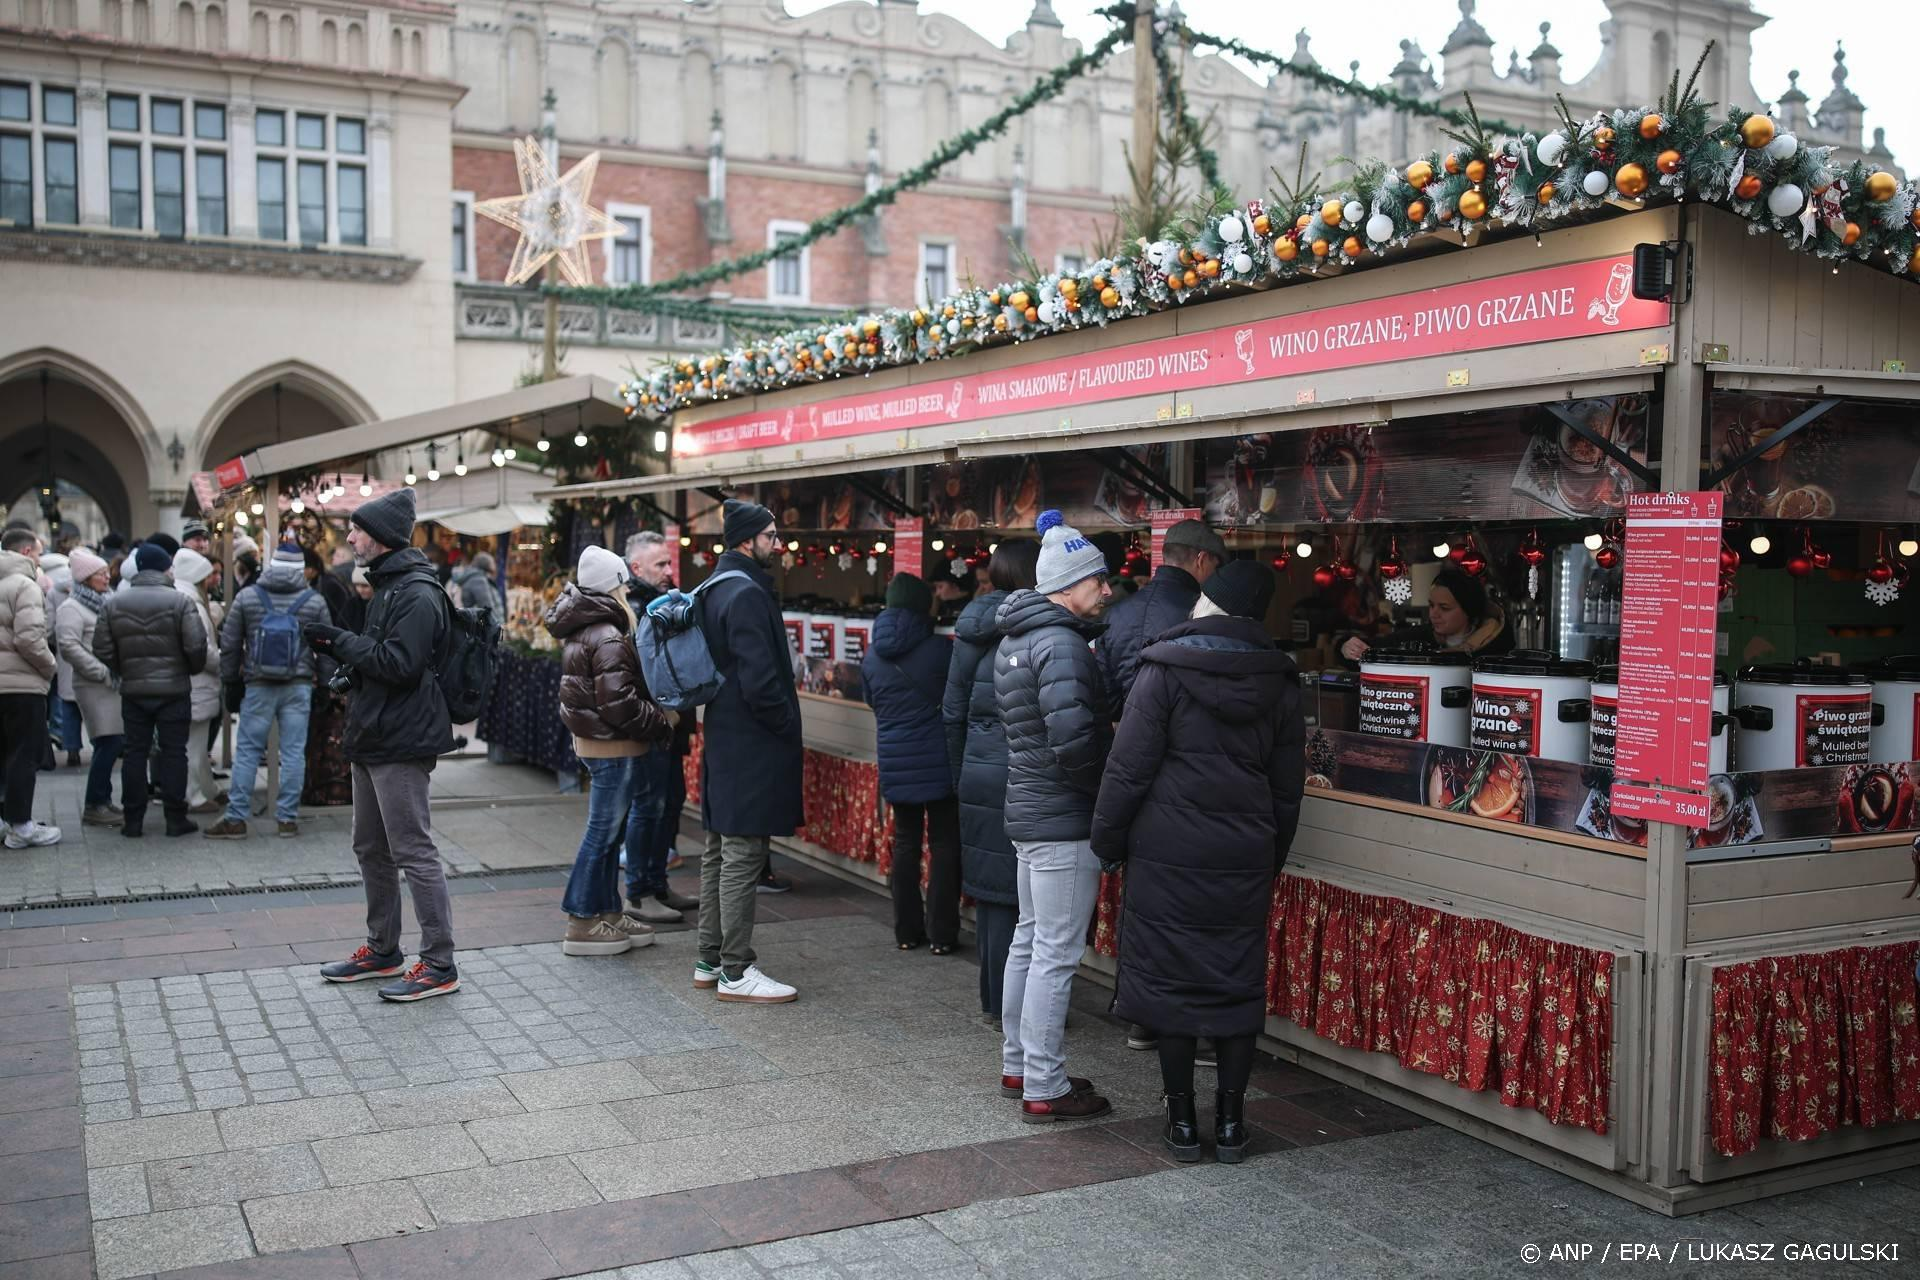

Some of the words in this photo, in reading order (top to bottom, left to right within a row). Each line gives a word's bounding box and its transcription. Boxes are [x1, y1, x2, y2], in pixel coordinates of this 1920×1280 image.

[1269, 329, 1318, 359] WINO
[1324, 315, 1408, 350] GRZANE,
[1413, 304, 1471, 337] PIWO
[1477, 287, 1575, 328] GRZANE
[978, 385, 1008, 404] WINA
[1008, 372, 1067, 400] SMAKOWE
[1069, 369, 1077, 396] /
[1079, 358, 1155, 389] FLAVOURED
[1158, 349, 1209, 377] WINES
[822, 407, 855, 427] MULLED
[882, 398, 918, 419] MULLED
[918, 393, 944, 414] BEER
[1630, 494, 1650, 506] Hot
[1652, 493, 1690, 505] drinks
[1064, 536, 1090, 553] HA
[1376, 690, 1414, 700] grzane
[1474, 698, 1510, 717] Wino
[1383, 715, 1406, 725] wine
[1815, 710, 1847, 721] Piwo
[1362, 722, 1402, 735] Christmas
[1472, 716, 1518, 732] grzane
[1492, 739, 1517, 750] wine
[1592, 742, 1615, 755] Mulled
[1822, 741, 1856, 751] Mulled
[1675, 803, 1698, 816] 35,00
[1699, 806, 1706, 817] zł
